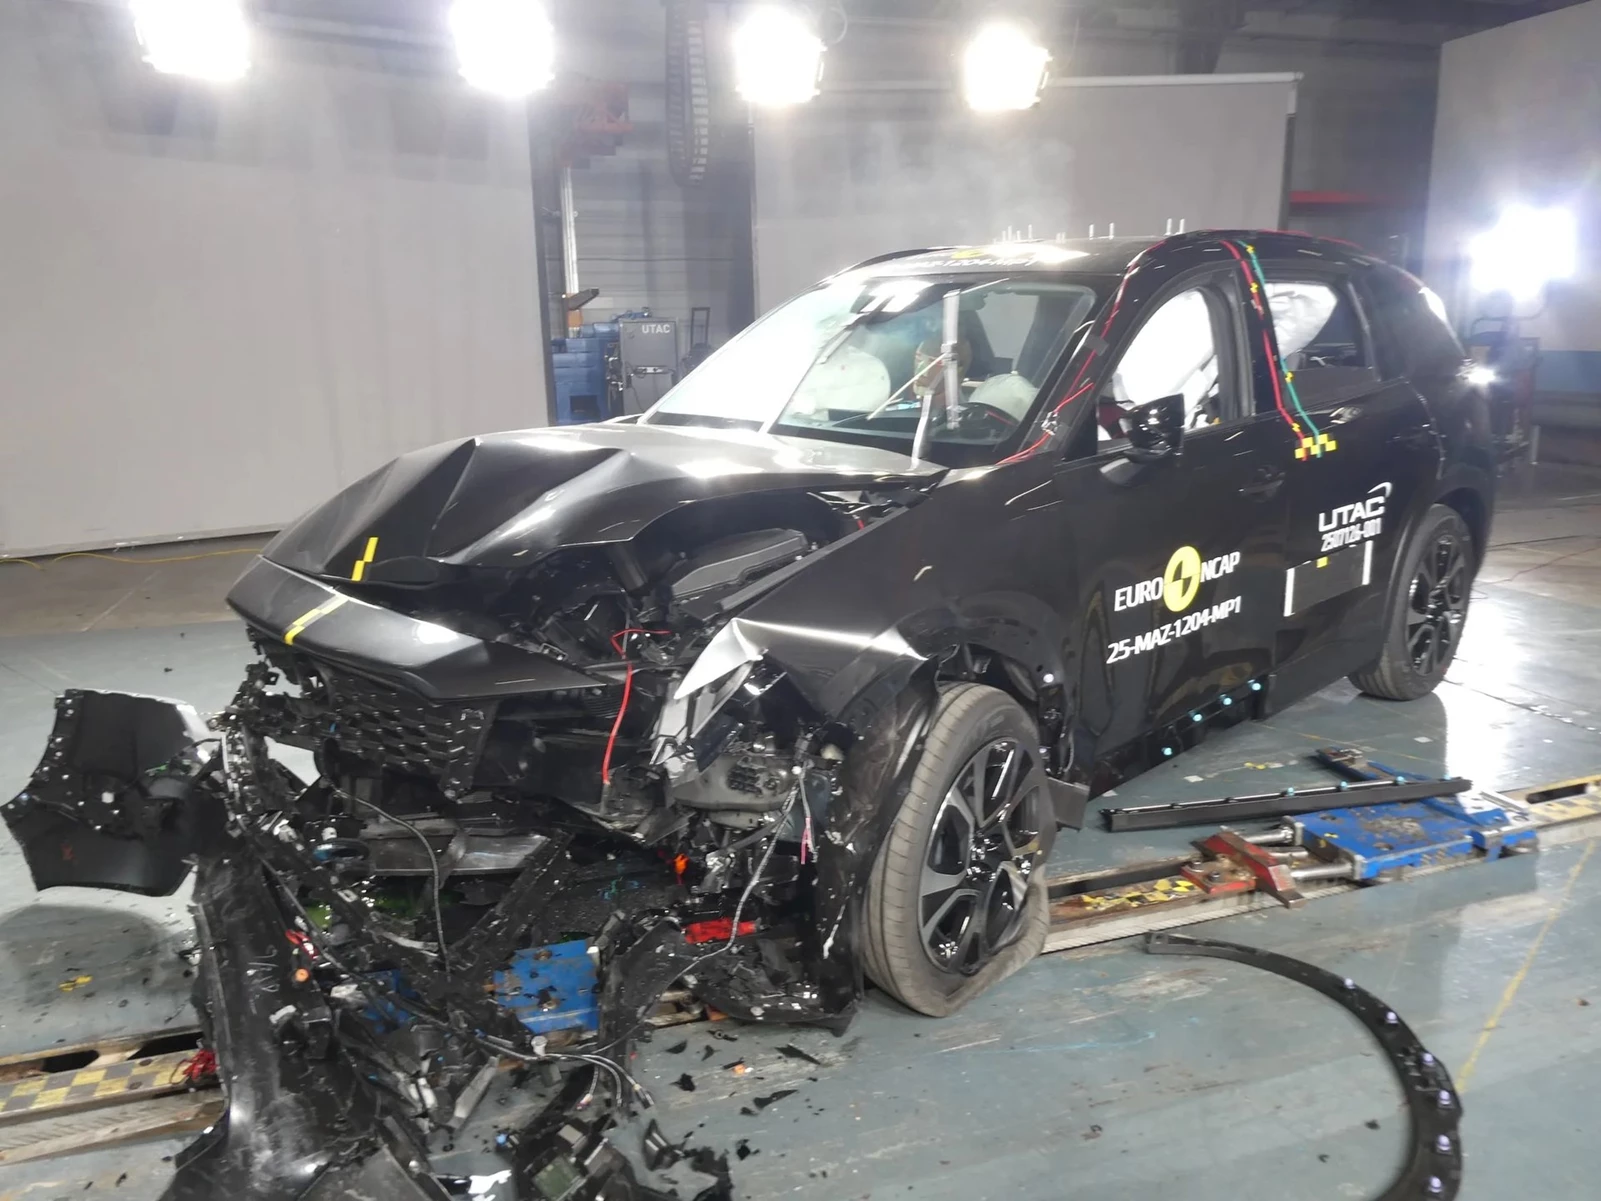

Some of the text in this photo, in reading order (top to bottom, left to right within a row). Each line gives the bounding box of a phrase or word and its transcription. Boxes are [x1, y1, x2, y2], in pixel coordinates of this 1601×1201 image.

[641, 324, 670, 334] UTAC
[1319, 496, 1385, 532] UTAC
[1114, 551, 1240, 612] EURO NCAP
[1106, 596, 1242, 664] 25-MAZ-1204-MP1
